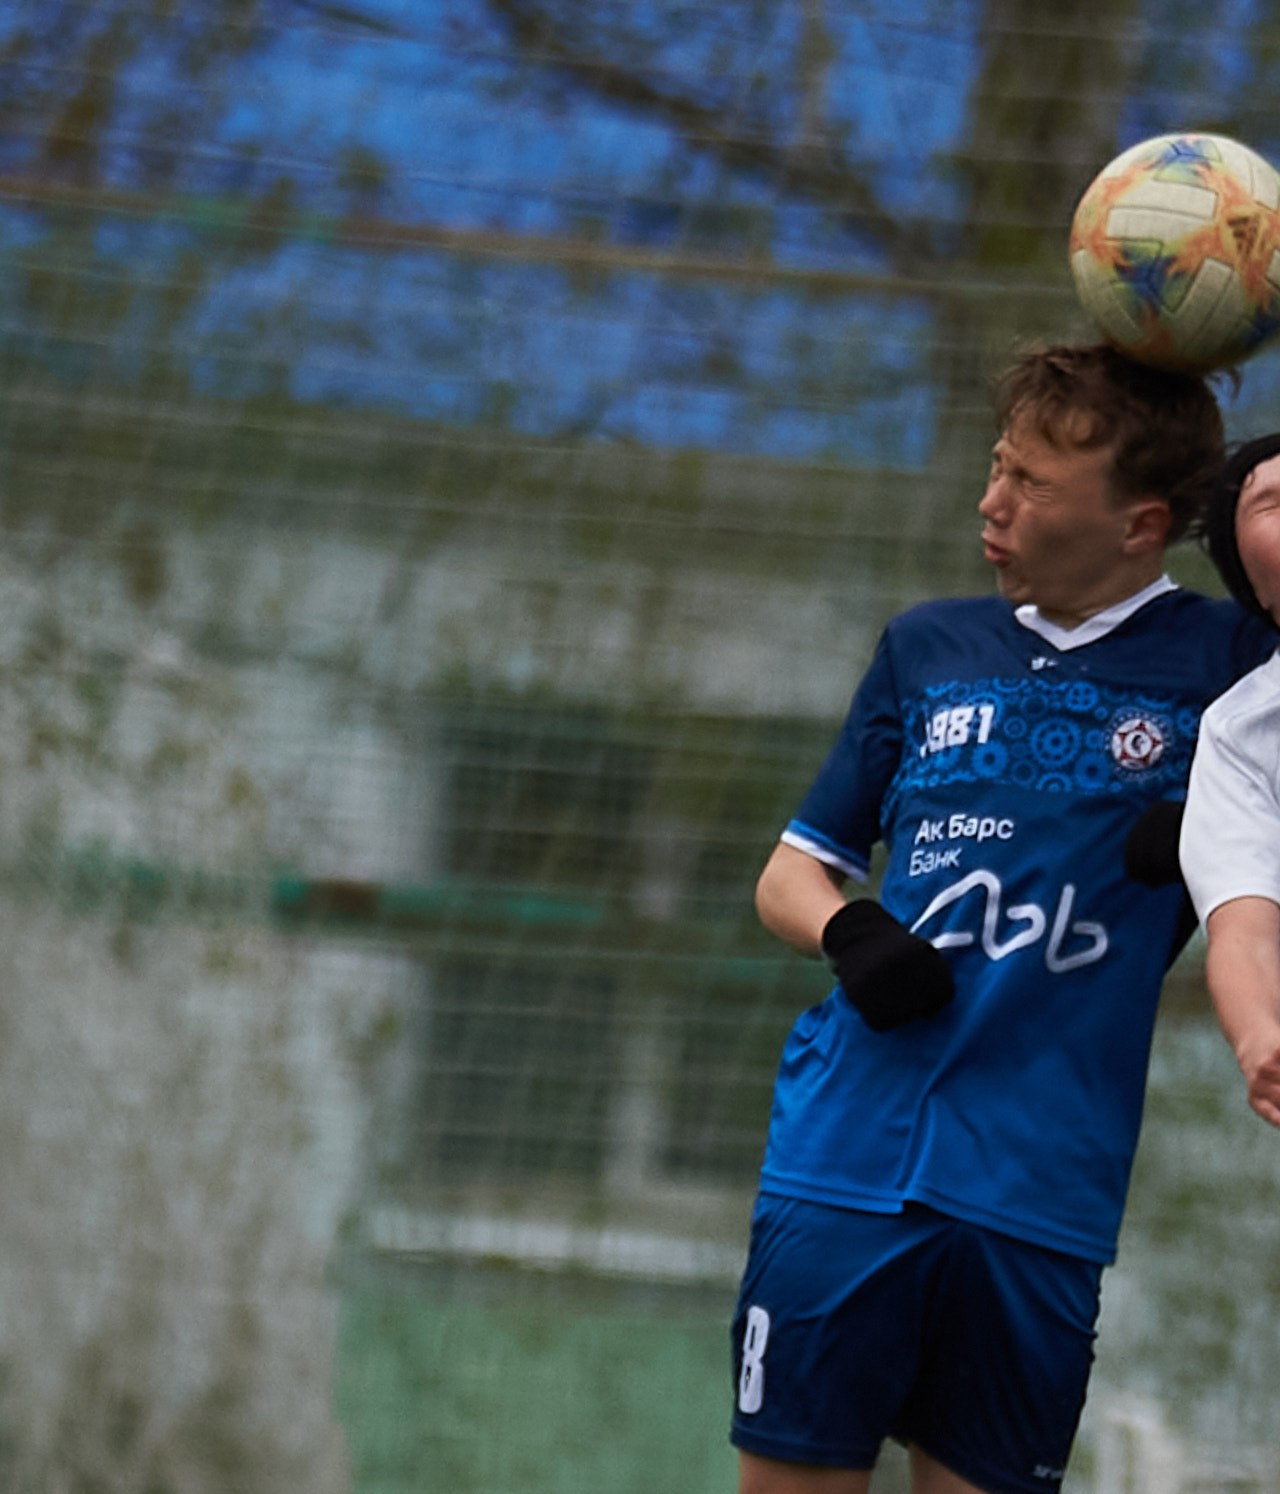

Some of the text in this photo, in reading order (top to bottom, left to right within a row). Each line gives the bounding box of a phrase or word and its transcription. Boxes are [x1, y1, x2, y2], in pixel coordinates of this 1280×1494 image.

[914, 814, 1014, 845] Ак Барс
[909, 847, 963, 877] Банк
[738, 1305, 770, 1414] 8
